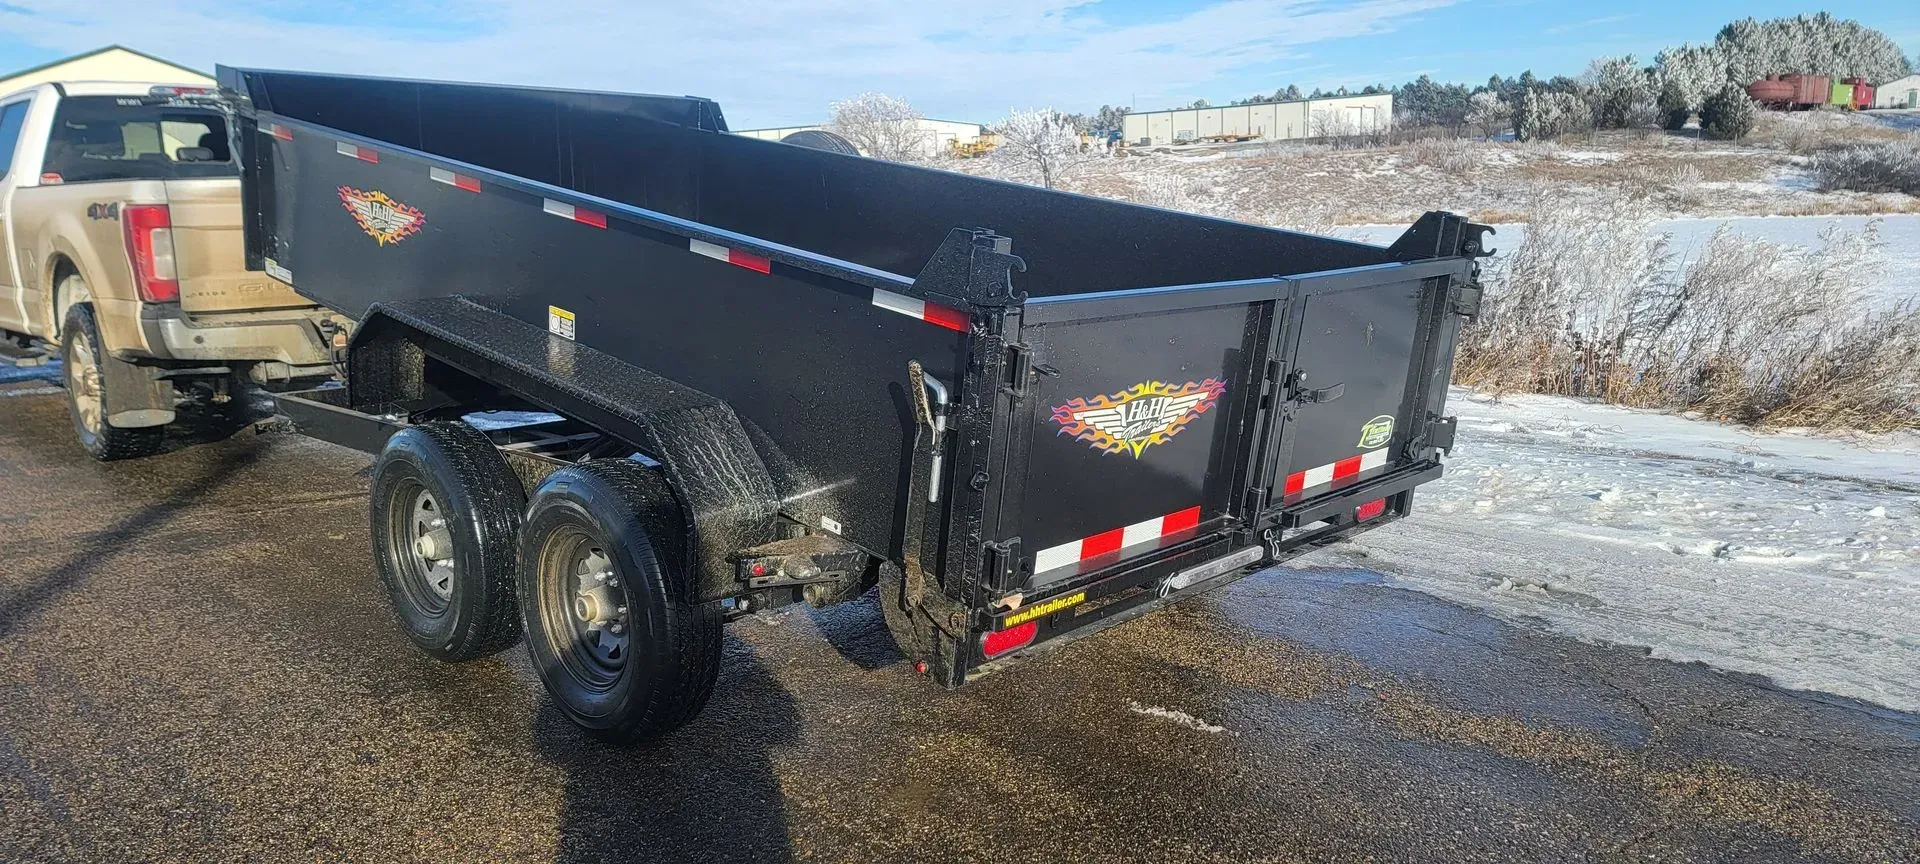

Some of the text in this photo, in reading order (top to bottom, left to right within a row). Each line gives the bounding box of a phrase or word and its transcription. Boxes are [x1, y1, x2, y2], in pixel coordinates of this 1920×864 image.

[372, 202, 391, 222] H&H
[1128, 397, 1165, 422] H&H
[1121, 418, 1162, 445] Trailers
[1005, 592, 1085, 627] www.hhtrailer.com
